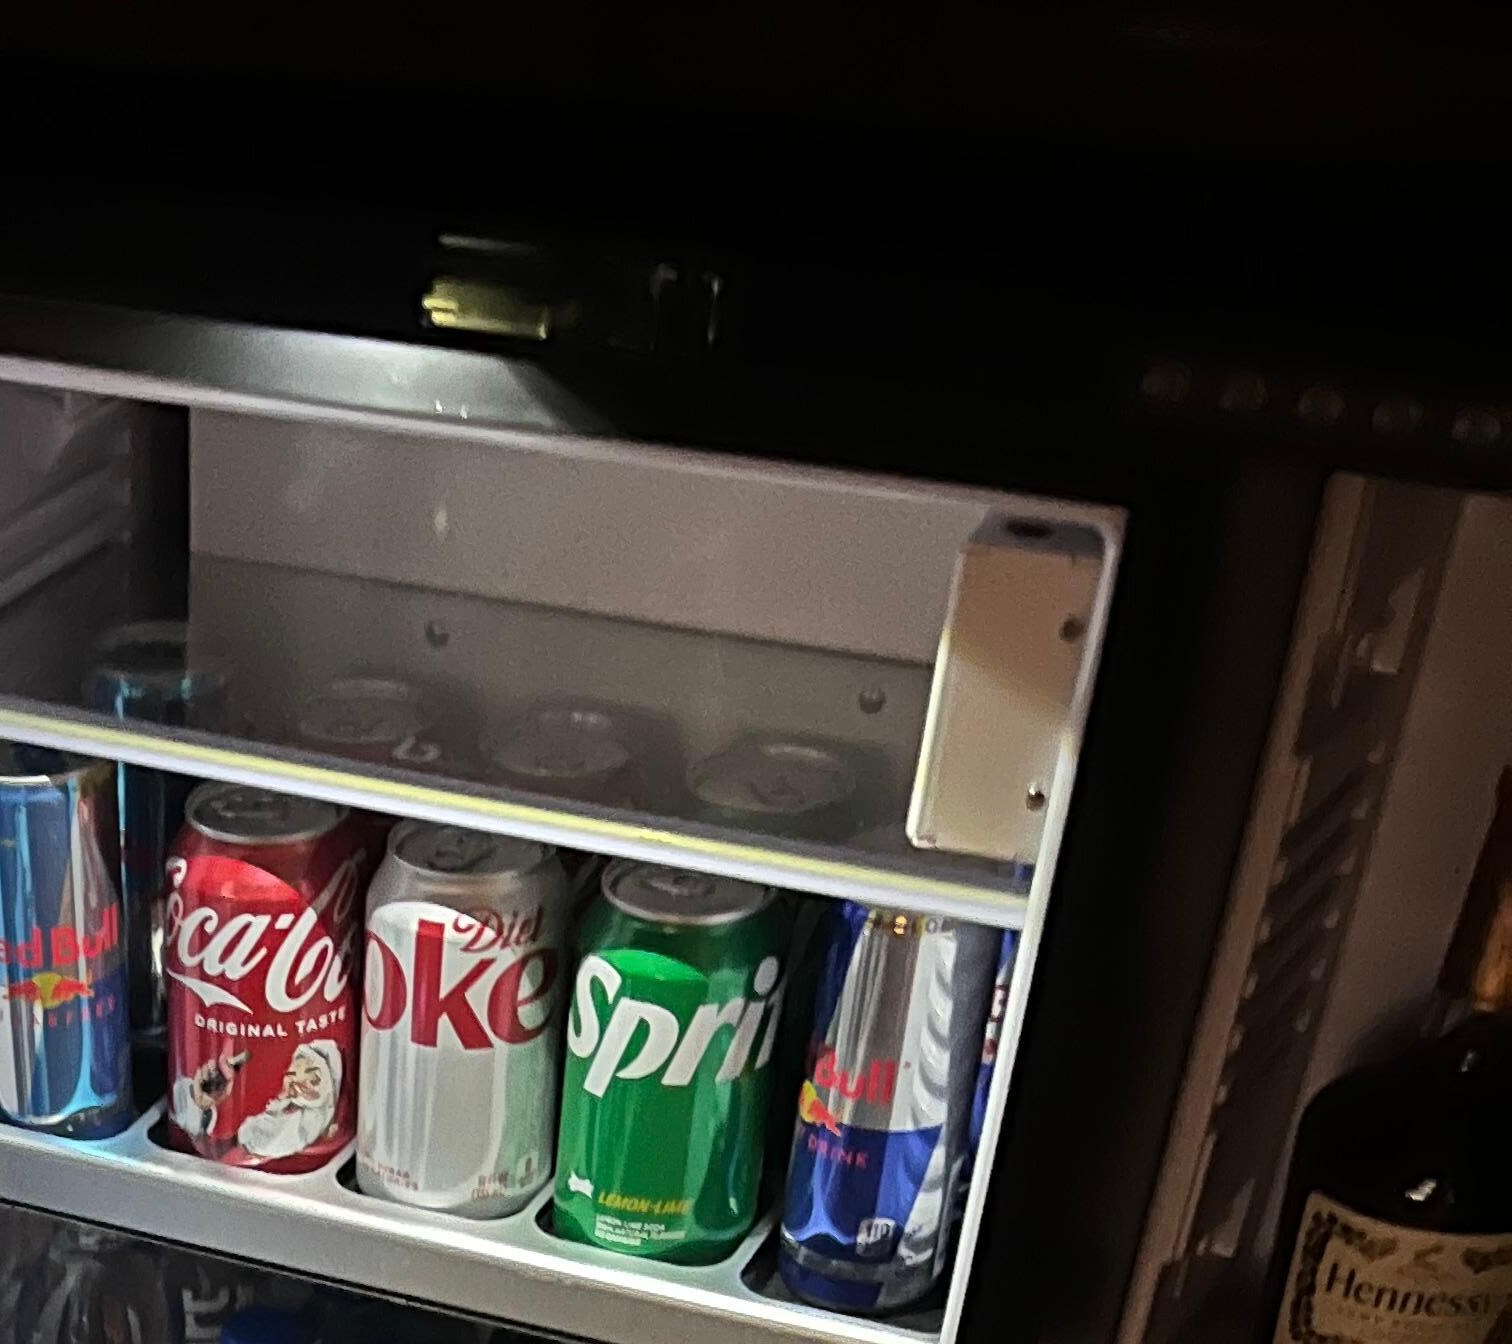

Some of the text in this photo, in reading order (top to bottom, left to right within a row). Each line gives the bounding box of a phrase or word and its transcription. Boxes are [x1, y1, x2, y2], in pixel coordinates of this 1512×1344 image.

[51, 902, 120, 967] Bull
[364, 920, 556, 1050] oke
[194, 1013, 289, 1038] ORIGINAL
[807, 1134, 869, 1169] DRINK
